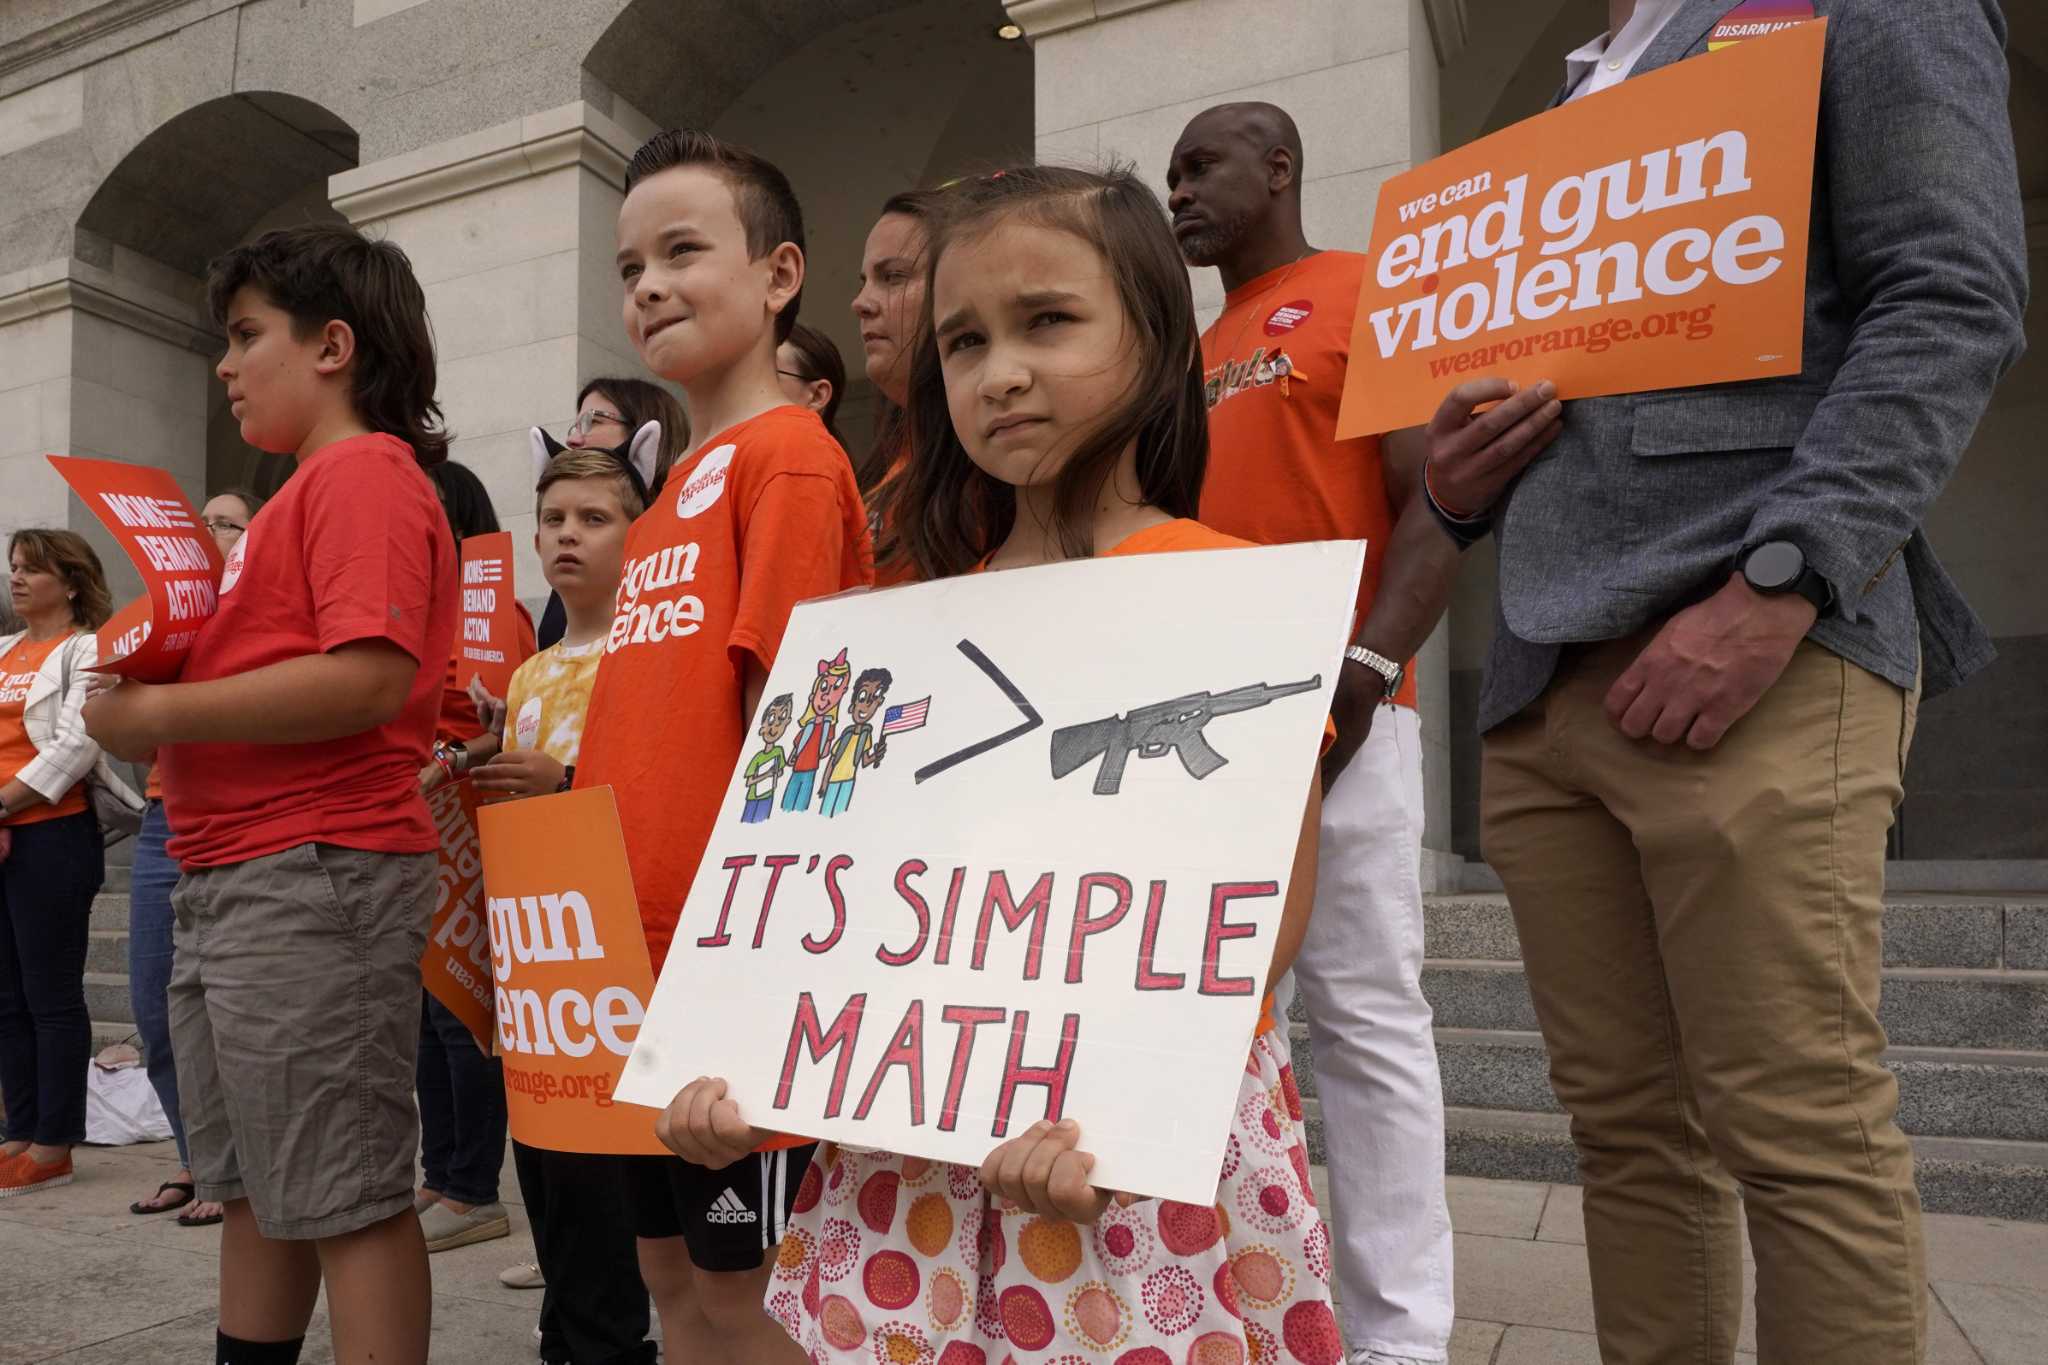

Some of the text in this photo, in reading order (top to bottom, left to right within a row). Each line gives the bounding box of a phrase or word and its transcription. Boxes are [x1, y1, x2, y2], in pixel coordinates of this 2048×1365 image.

[1714, 23, 1772, 38] DISARM
[1376, 129, 1752, 289] end gun
[1398, 169, 1493, 223] we can
[1368, 214, 1785, 360] violence
[1428, 304, 1717, 380] wearorange.org
[98, 492, 173, 529] MOMS
[133, 535, 211, 572] DEMAND
[164, 579, 218, 622] ACTION
[463, 587, 497, 613] DEMAND
[463, 617, 490, 642] ACTION
[487, 890, 605, 982] gun
[696, 853, 1280, 997] IT'S SIMPLE
[445, 953, 475, 991] can
[496, 985, 646, 1058] ence
[772, 990, 1081, 1139] MATH
[706, 1208, 757, 1224] adidas
